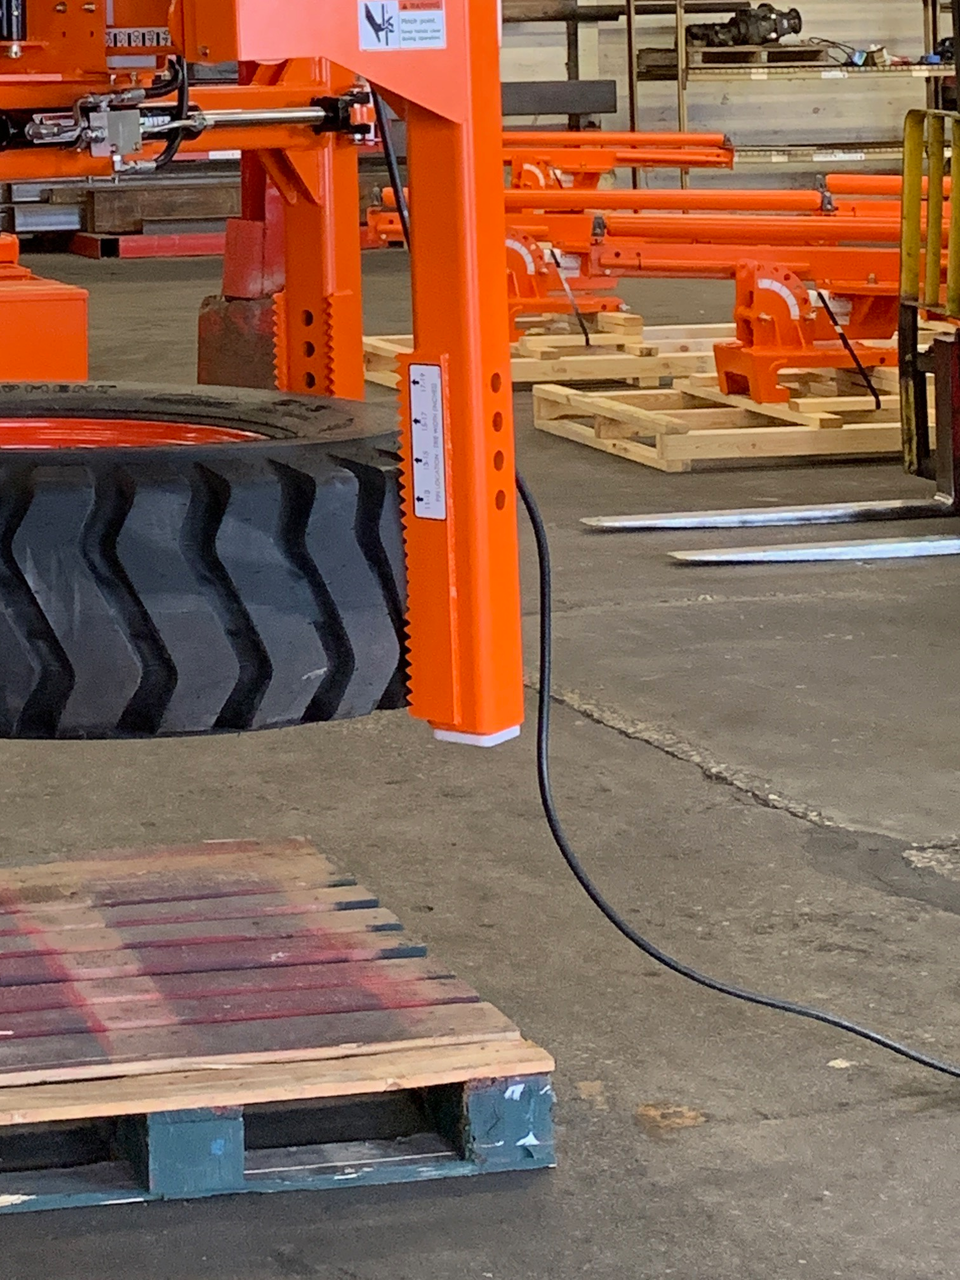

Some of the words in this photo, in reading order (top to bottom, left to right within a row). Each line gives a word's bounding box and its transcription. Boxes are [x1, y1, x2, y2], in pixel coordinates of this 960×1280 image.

[118, 30, 126, 44] 52
[132, 29, 141, 44] 50
[147, 29, 156, 43] 48
[422, 450, 430, 471] 13-15
